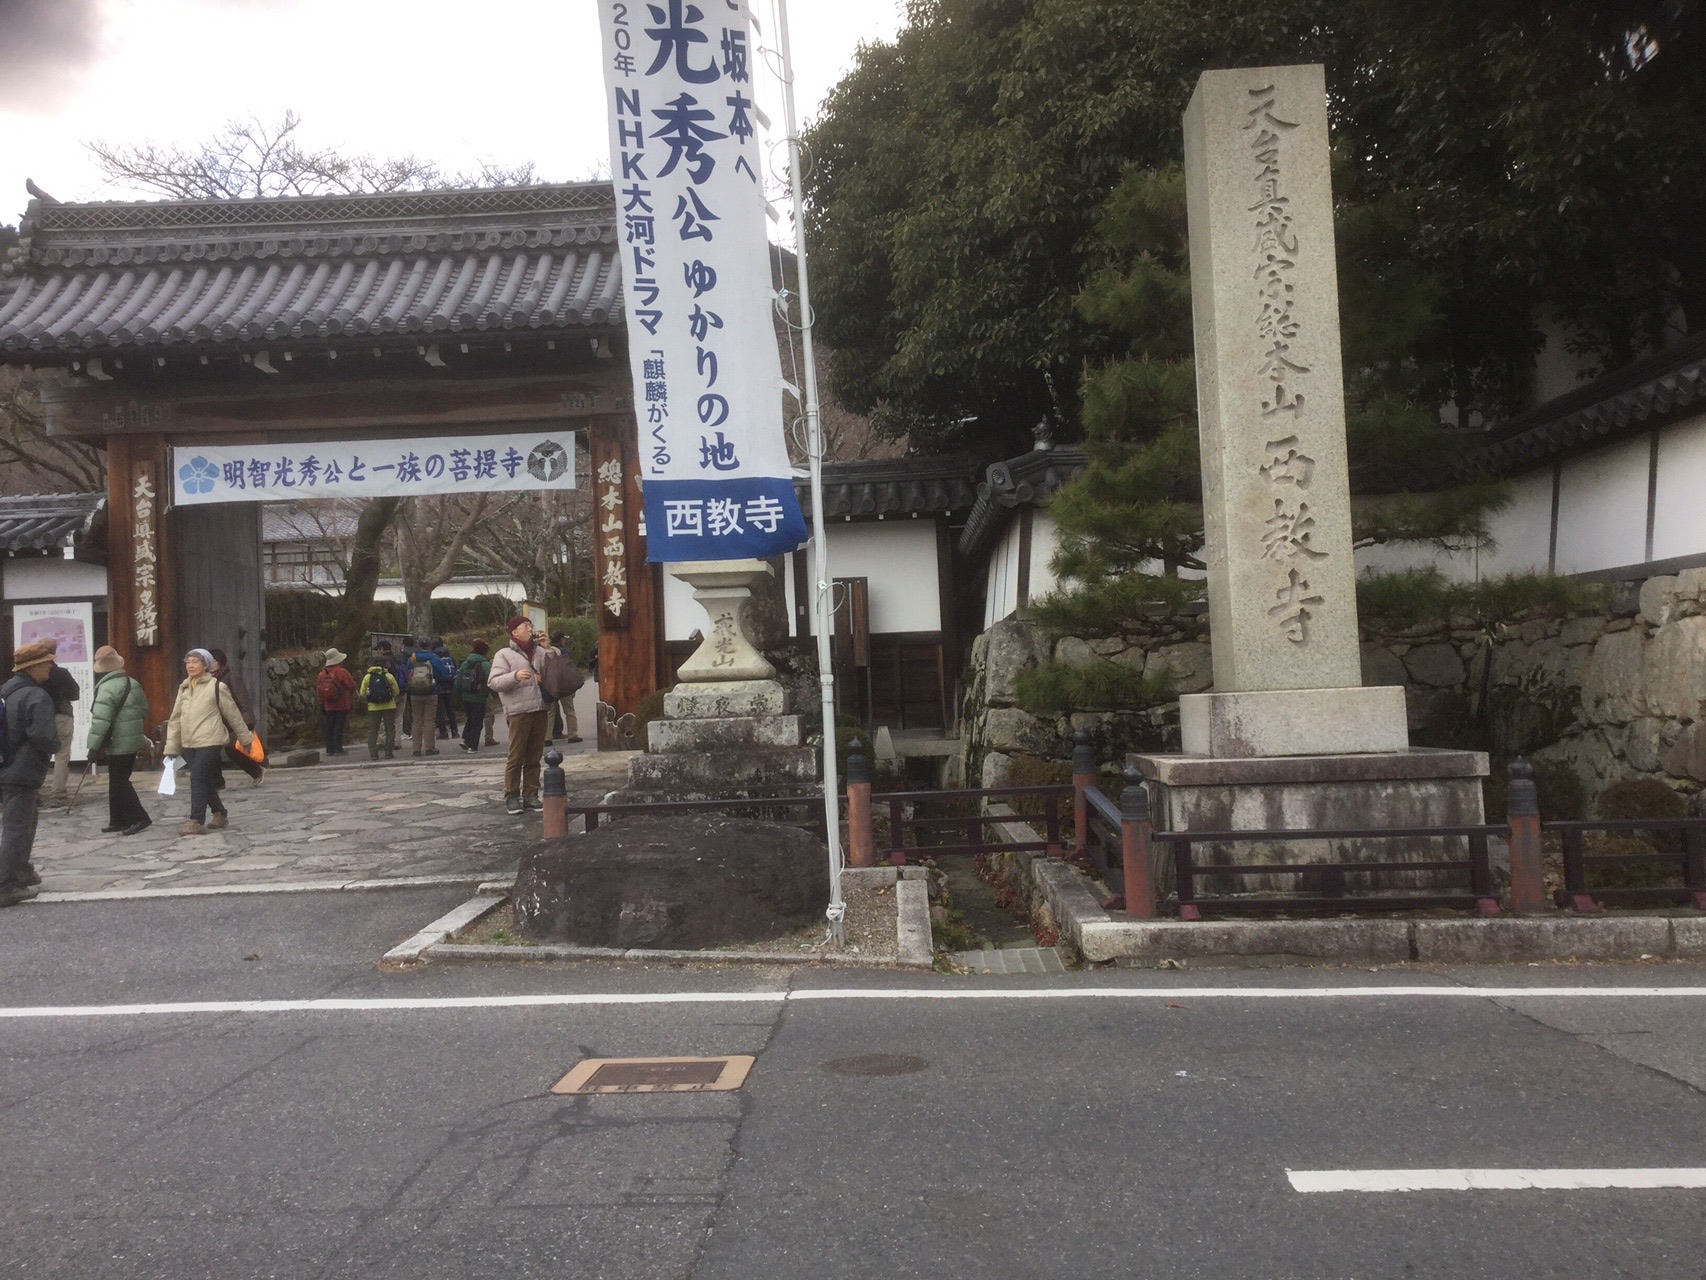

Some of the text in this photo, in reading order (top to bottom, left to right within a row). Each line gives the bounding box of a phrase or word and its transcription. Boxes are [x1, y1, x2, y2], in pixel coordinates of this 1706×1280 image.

[721, 0, 757, 184] 坂本へ
[644, 0, 740, 470] 光秀公ゆかりの地
[223, 446, 524, 489] 明智光秀公と一族の菩提寺
[597, 458, 627, 617] 總本山西教寺
[663, 495, 784, 537] 西教寺
